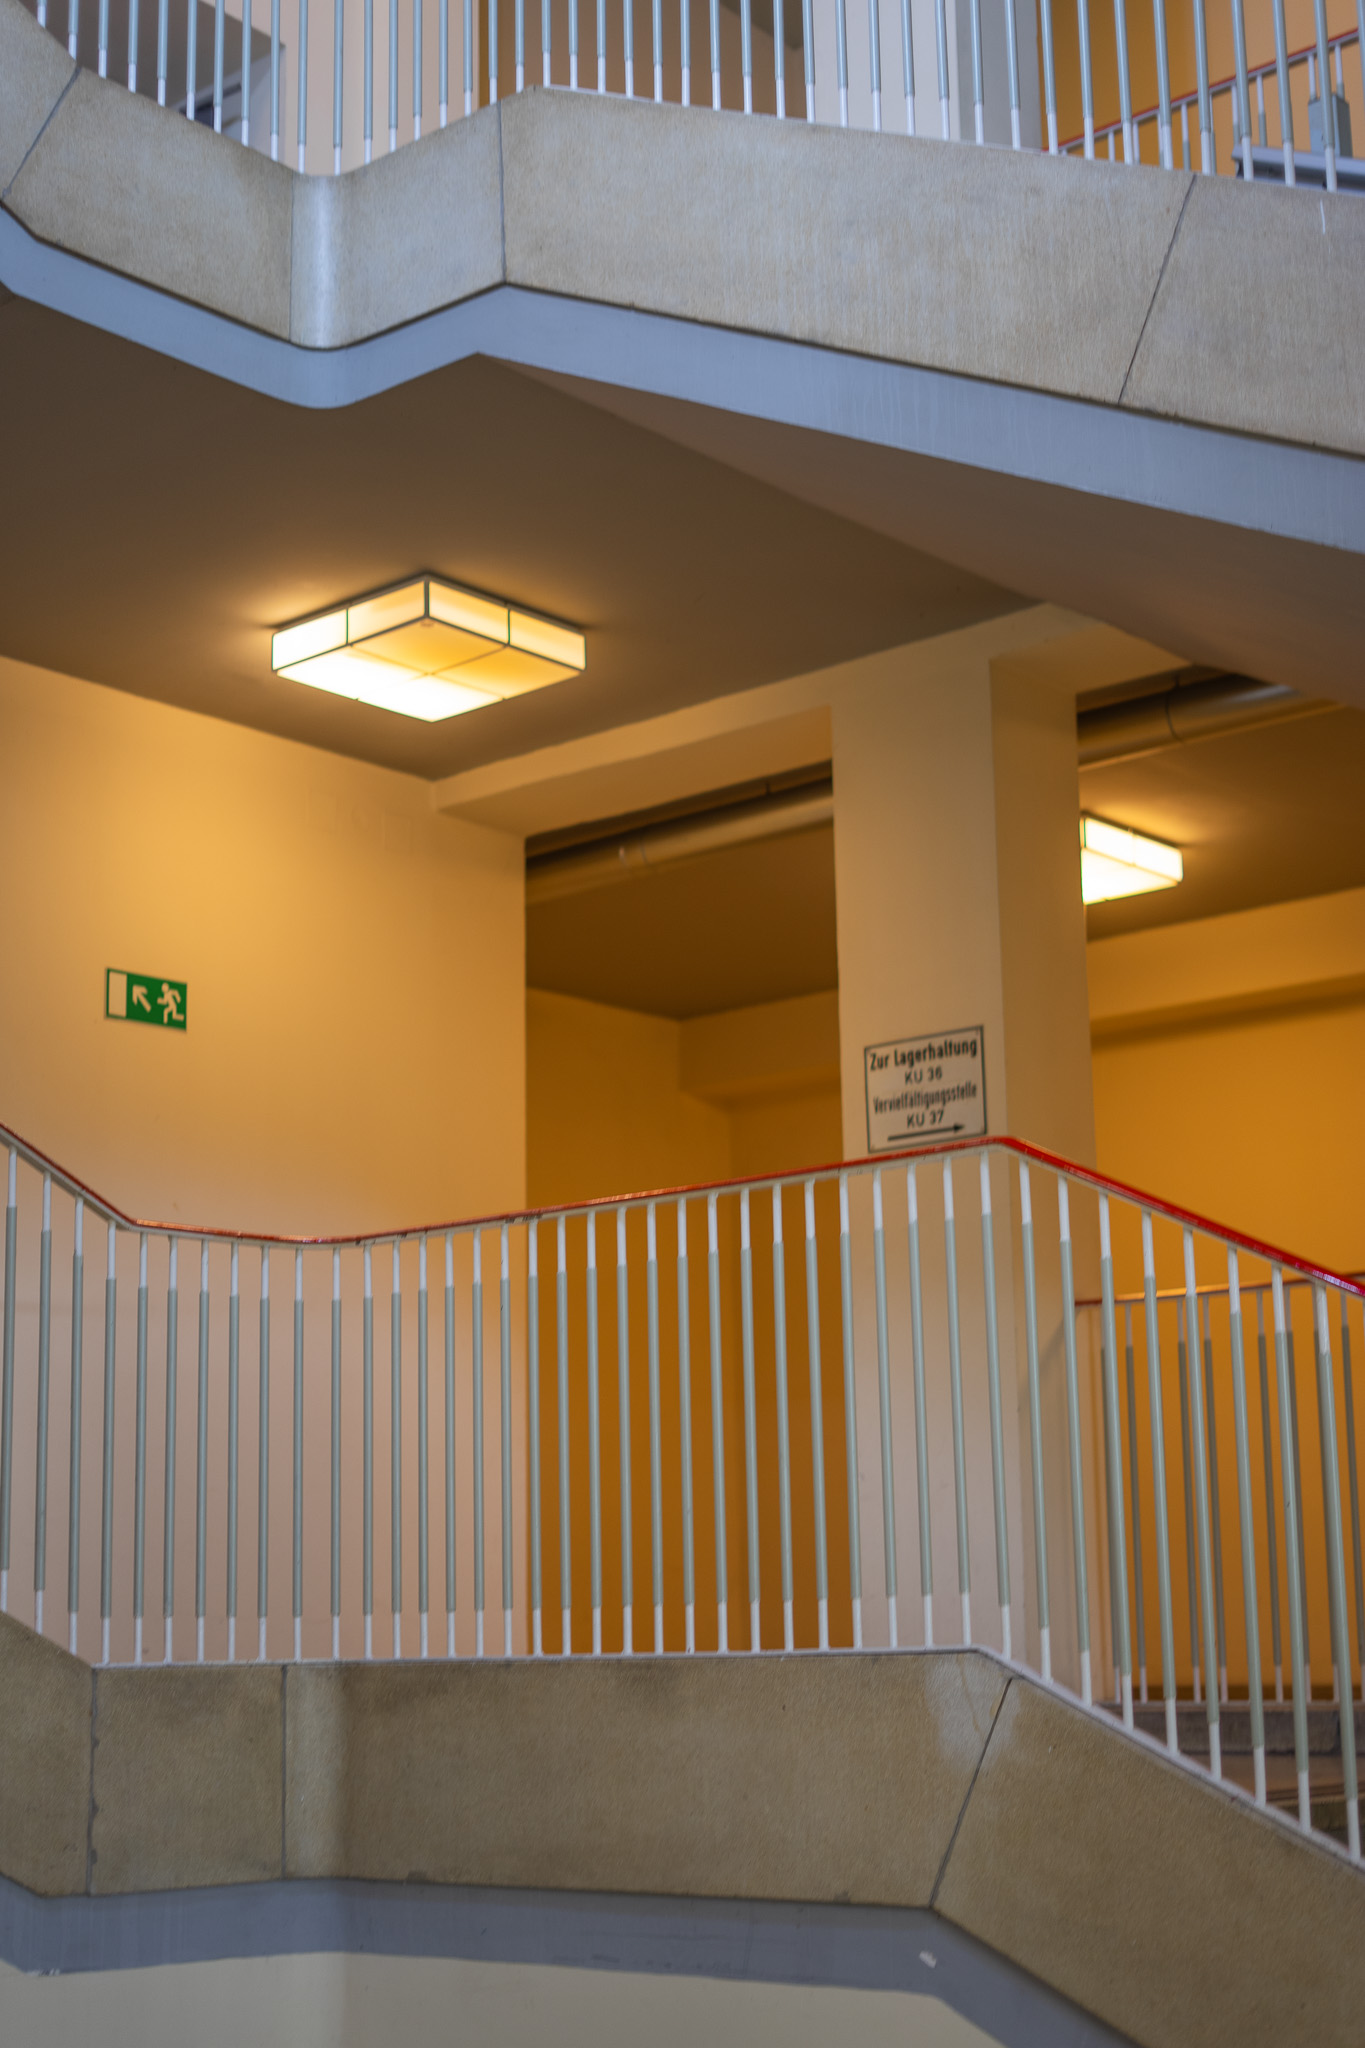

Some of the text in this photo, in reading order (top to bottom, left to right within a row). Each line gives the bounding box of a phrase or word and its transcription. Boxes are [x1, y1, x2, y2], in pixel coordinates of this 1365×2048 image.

[870, 1039, 977, 1071] Zur Lagerhaltung
[905, 1066, 942, 1085] KU 36
[906, 1109, 944, 1129] KU 37
